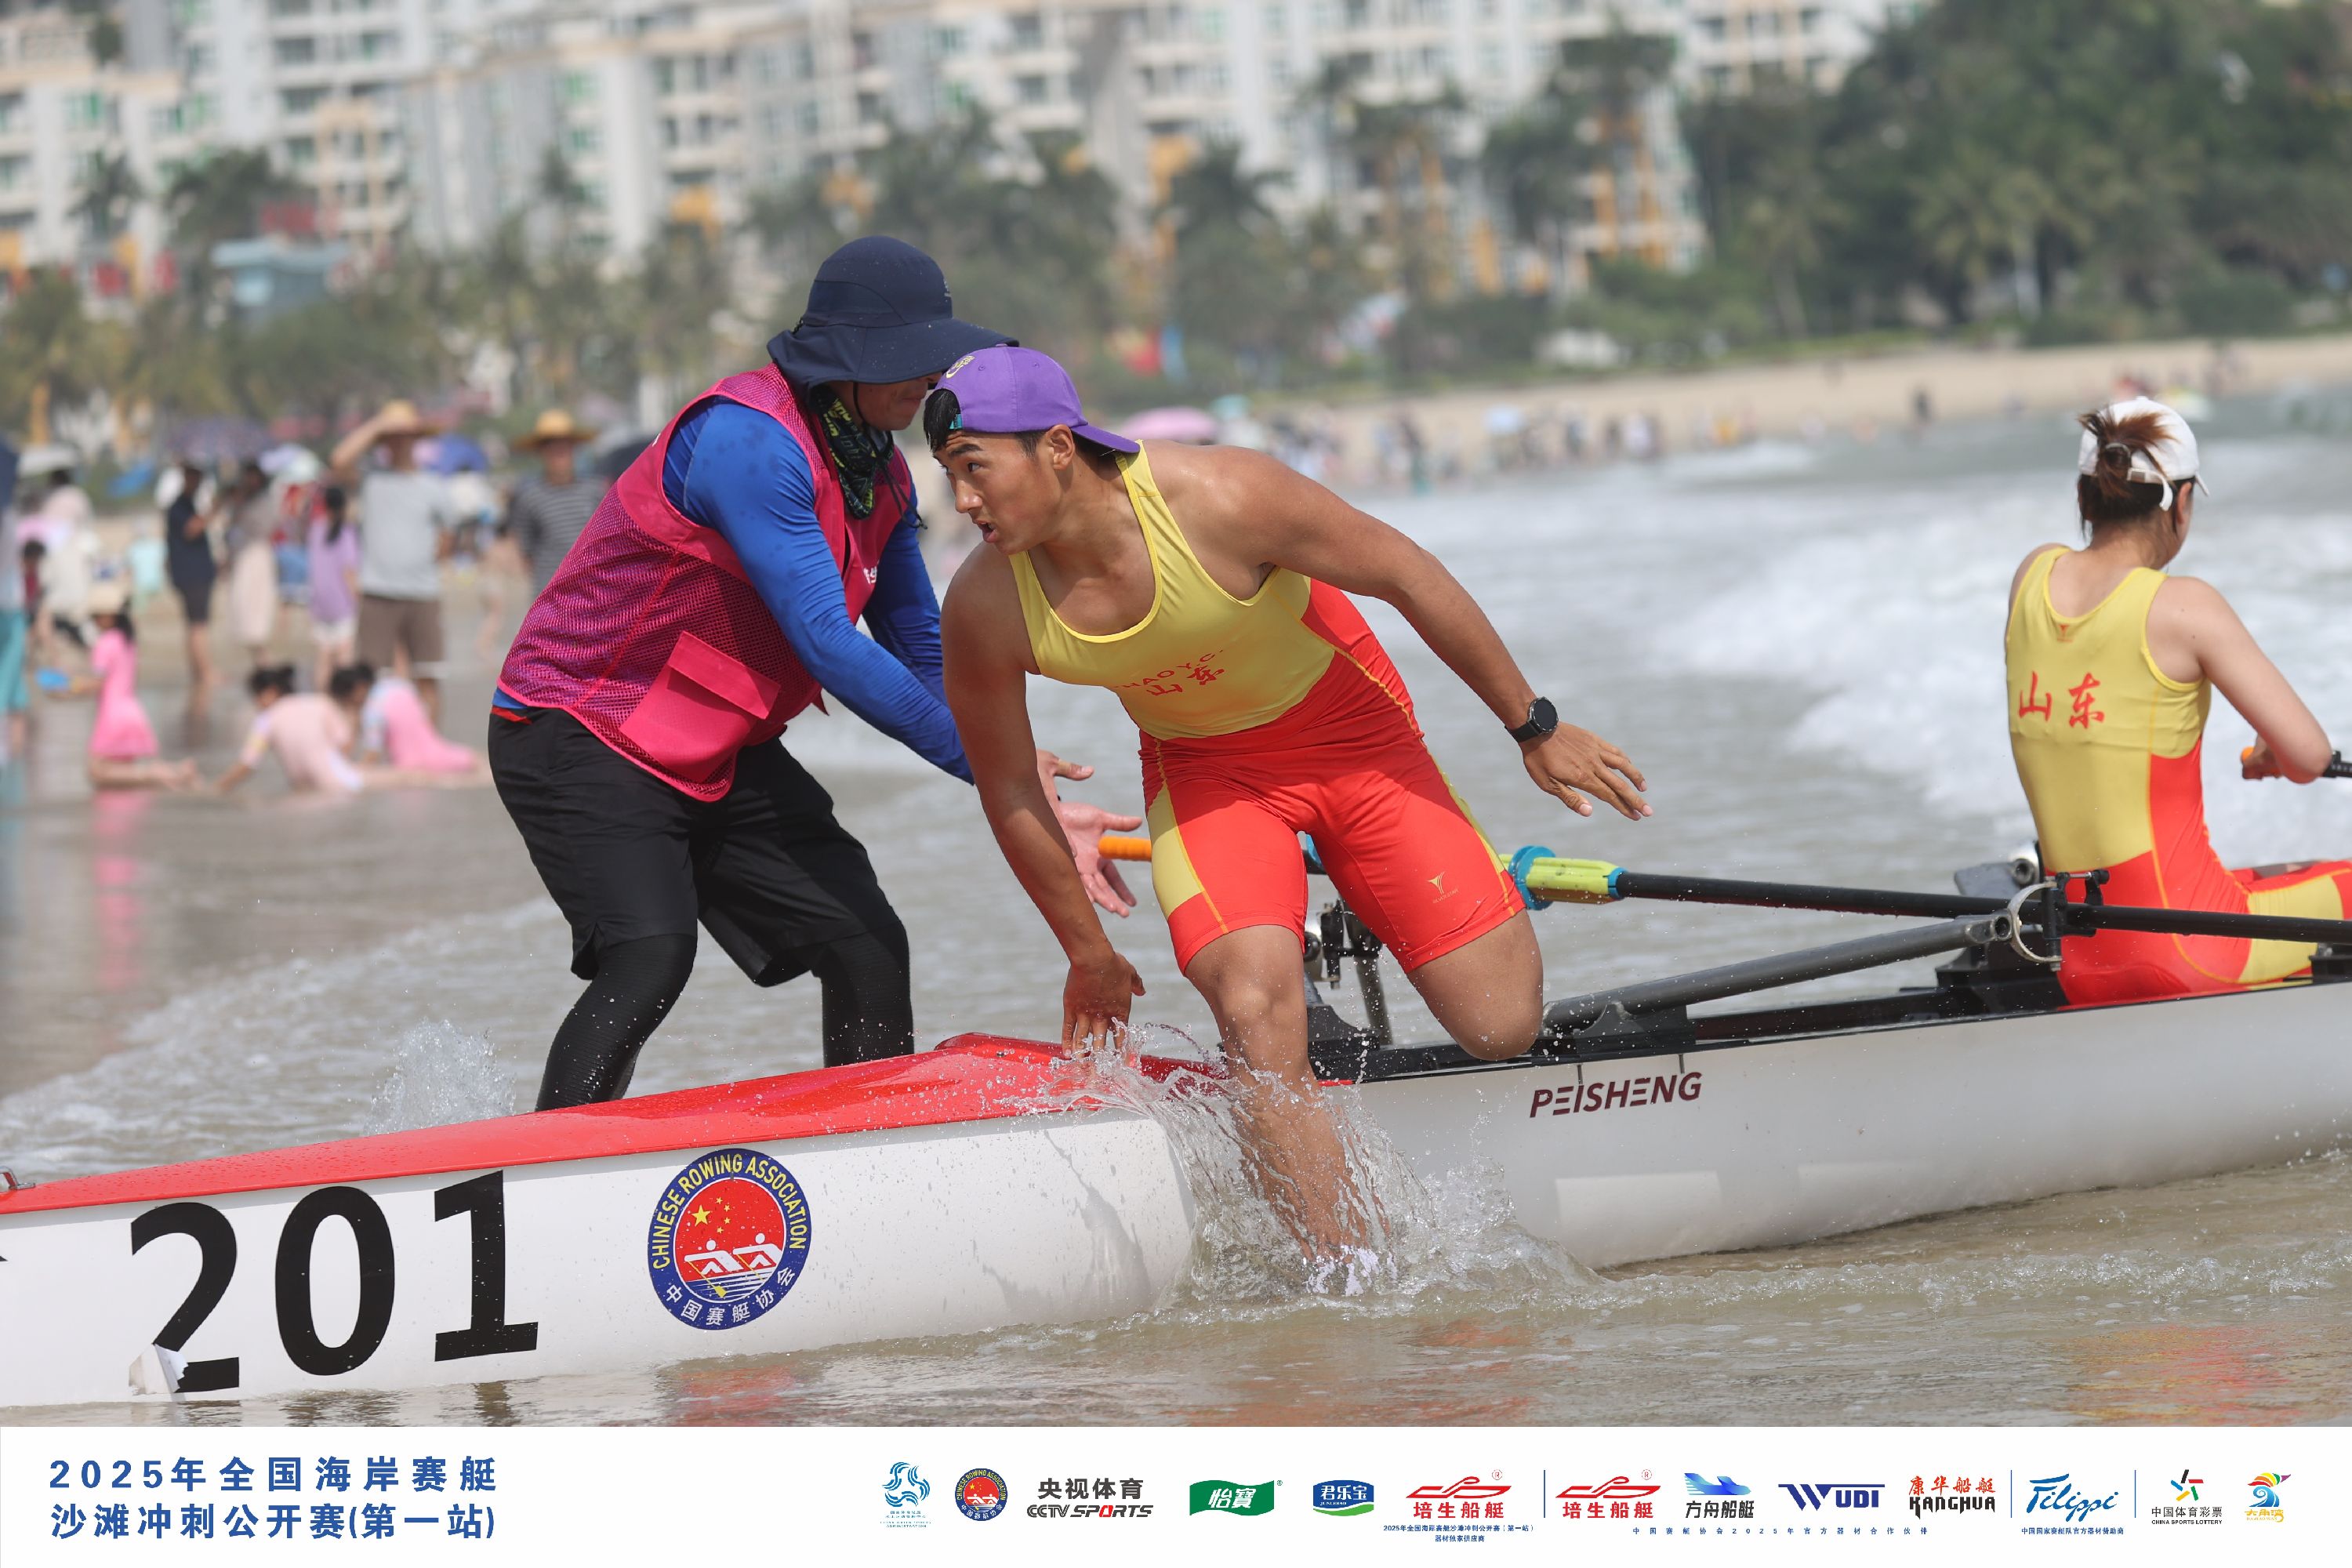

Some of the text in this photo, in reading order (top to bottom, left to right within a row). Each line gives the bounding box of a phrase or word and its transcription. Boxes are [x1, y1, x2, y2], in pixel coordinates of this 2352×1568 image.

[1146, 665, 1225, 696] 山东
[2018, 671, 2105, 729] 山东
[1530, 1072, 1703, 1118] PEISHENG
[652, 1153, 807, 1270] CHINESE ROWING ASSOCIATION
[130, 1170, 539, 1393] 201
[666, 1266, 796, 1327] 中国赛艇协会
